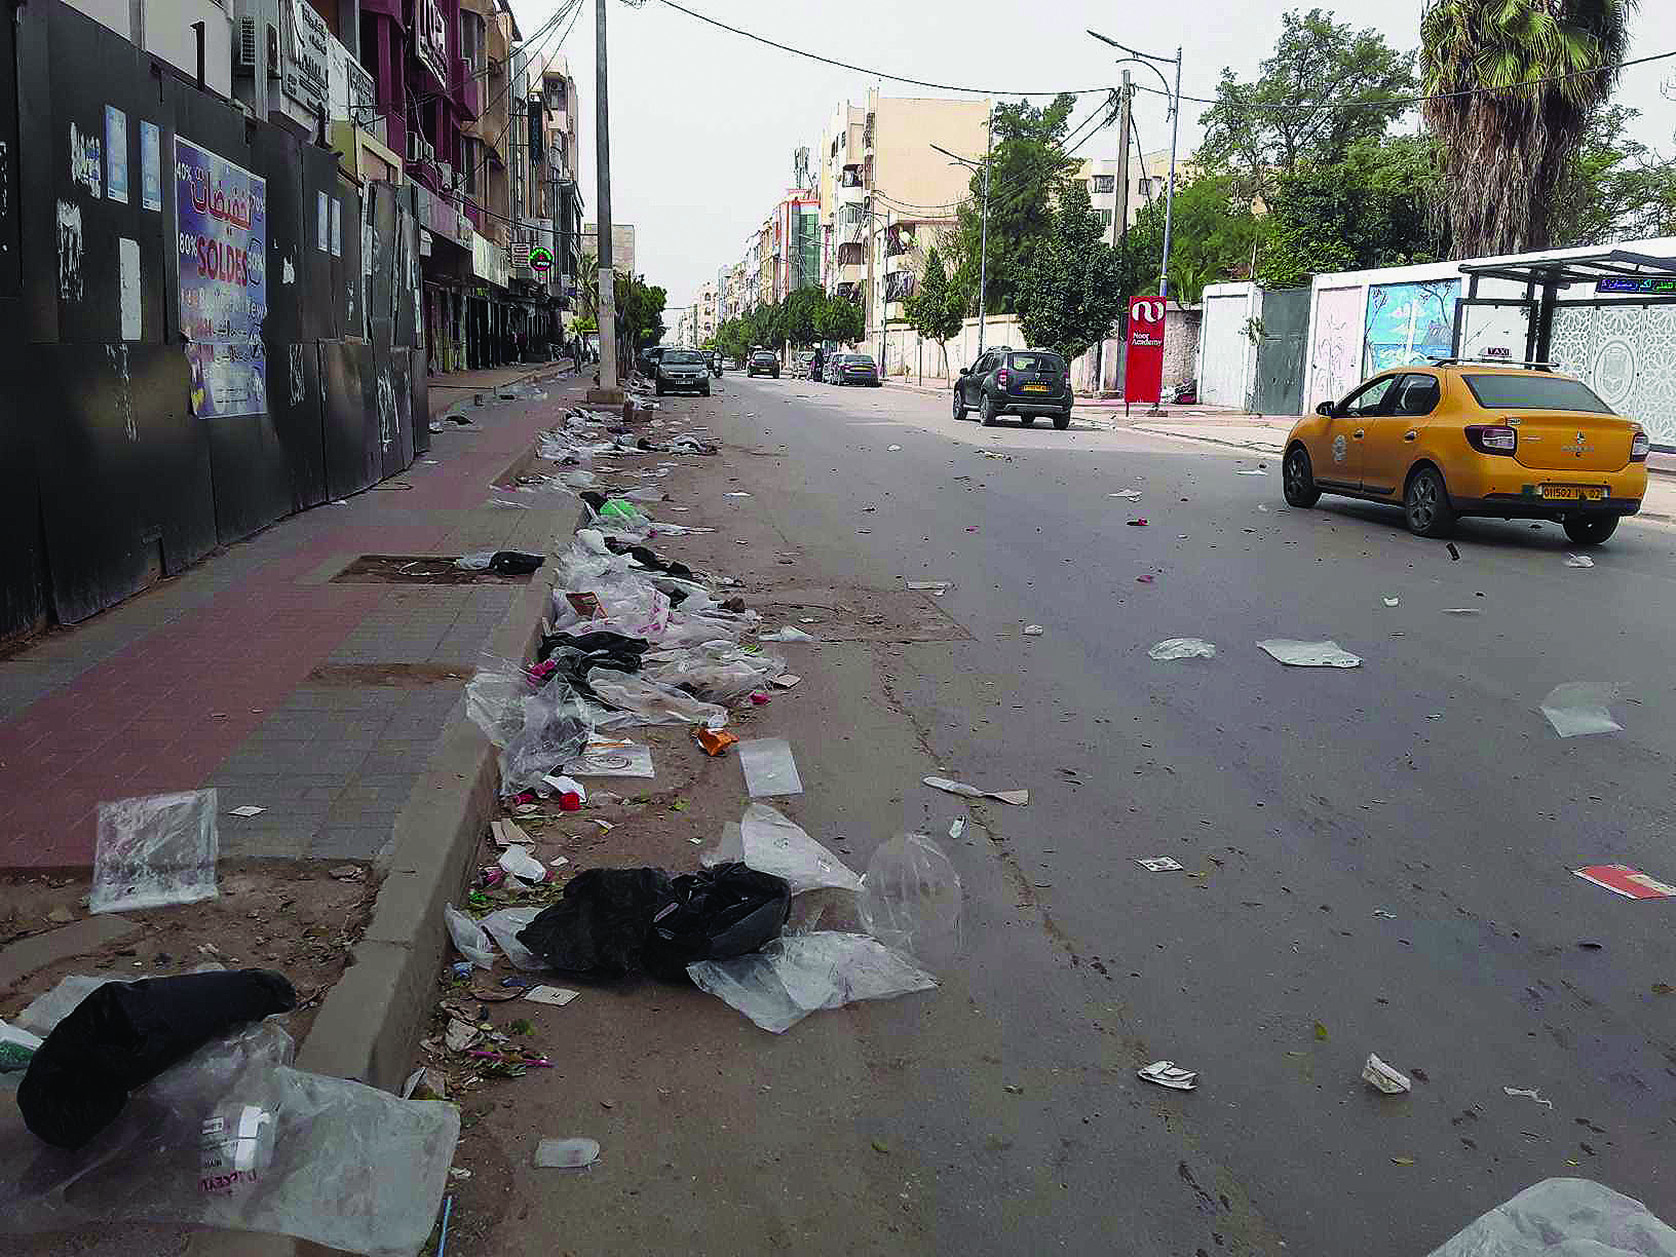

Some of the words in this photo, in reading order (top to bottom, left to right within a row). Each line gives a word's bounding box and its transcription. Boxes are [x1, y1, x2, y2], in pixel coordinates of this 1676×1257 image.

[190, 166, 252, 236] تخفيضات
[179, 231, 198, 258] 80%
[197, 236, 248, 287] SOLDES
[1133, 332, 1150, 340] Noor
[1487, 347, 1510, 356] TAXI
